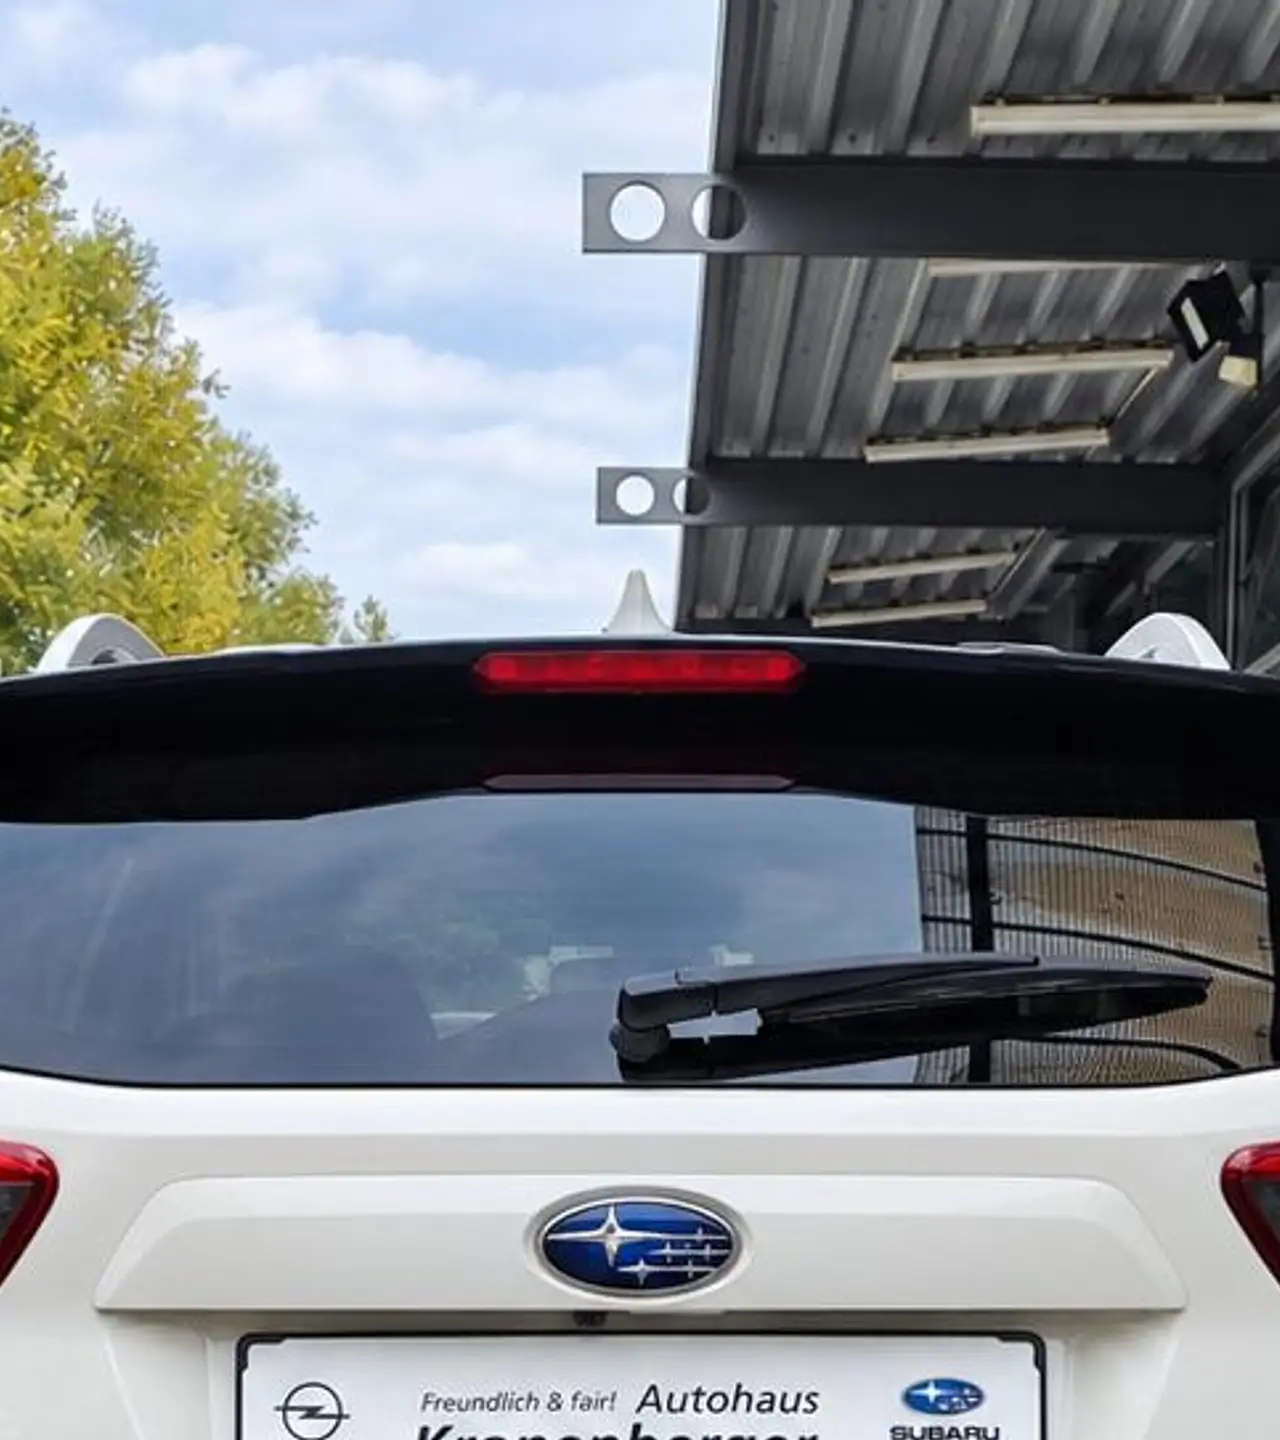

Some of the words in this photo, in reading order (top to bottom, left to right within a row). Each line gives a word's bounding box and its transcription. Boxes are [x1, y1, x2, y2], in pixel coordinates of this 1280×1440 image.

[421, 1391, 540, 1413] Freundlich
[546, 1391, 563, 1412] &
[570, 1390, 618, 1413] fair!
[634, 1382, 820, 1415] Autohaus
